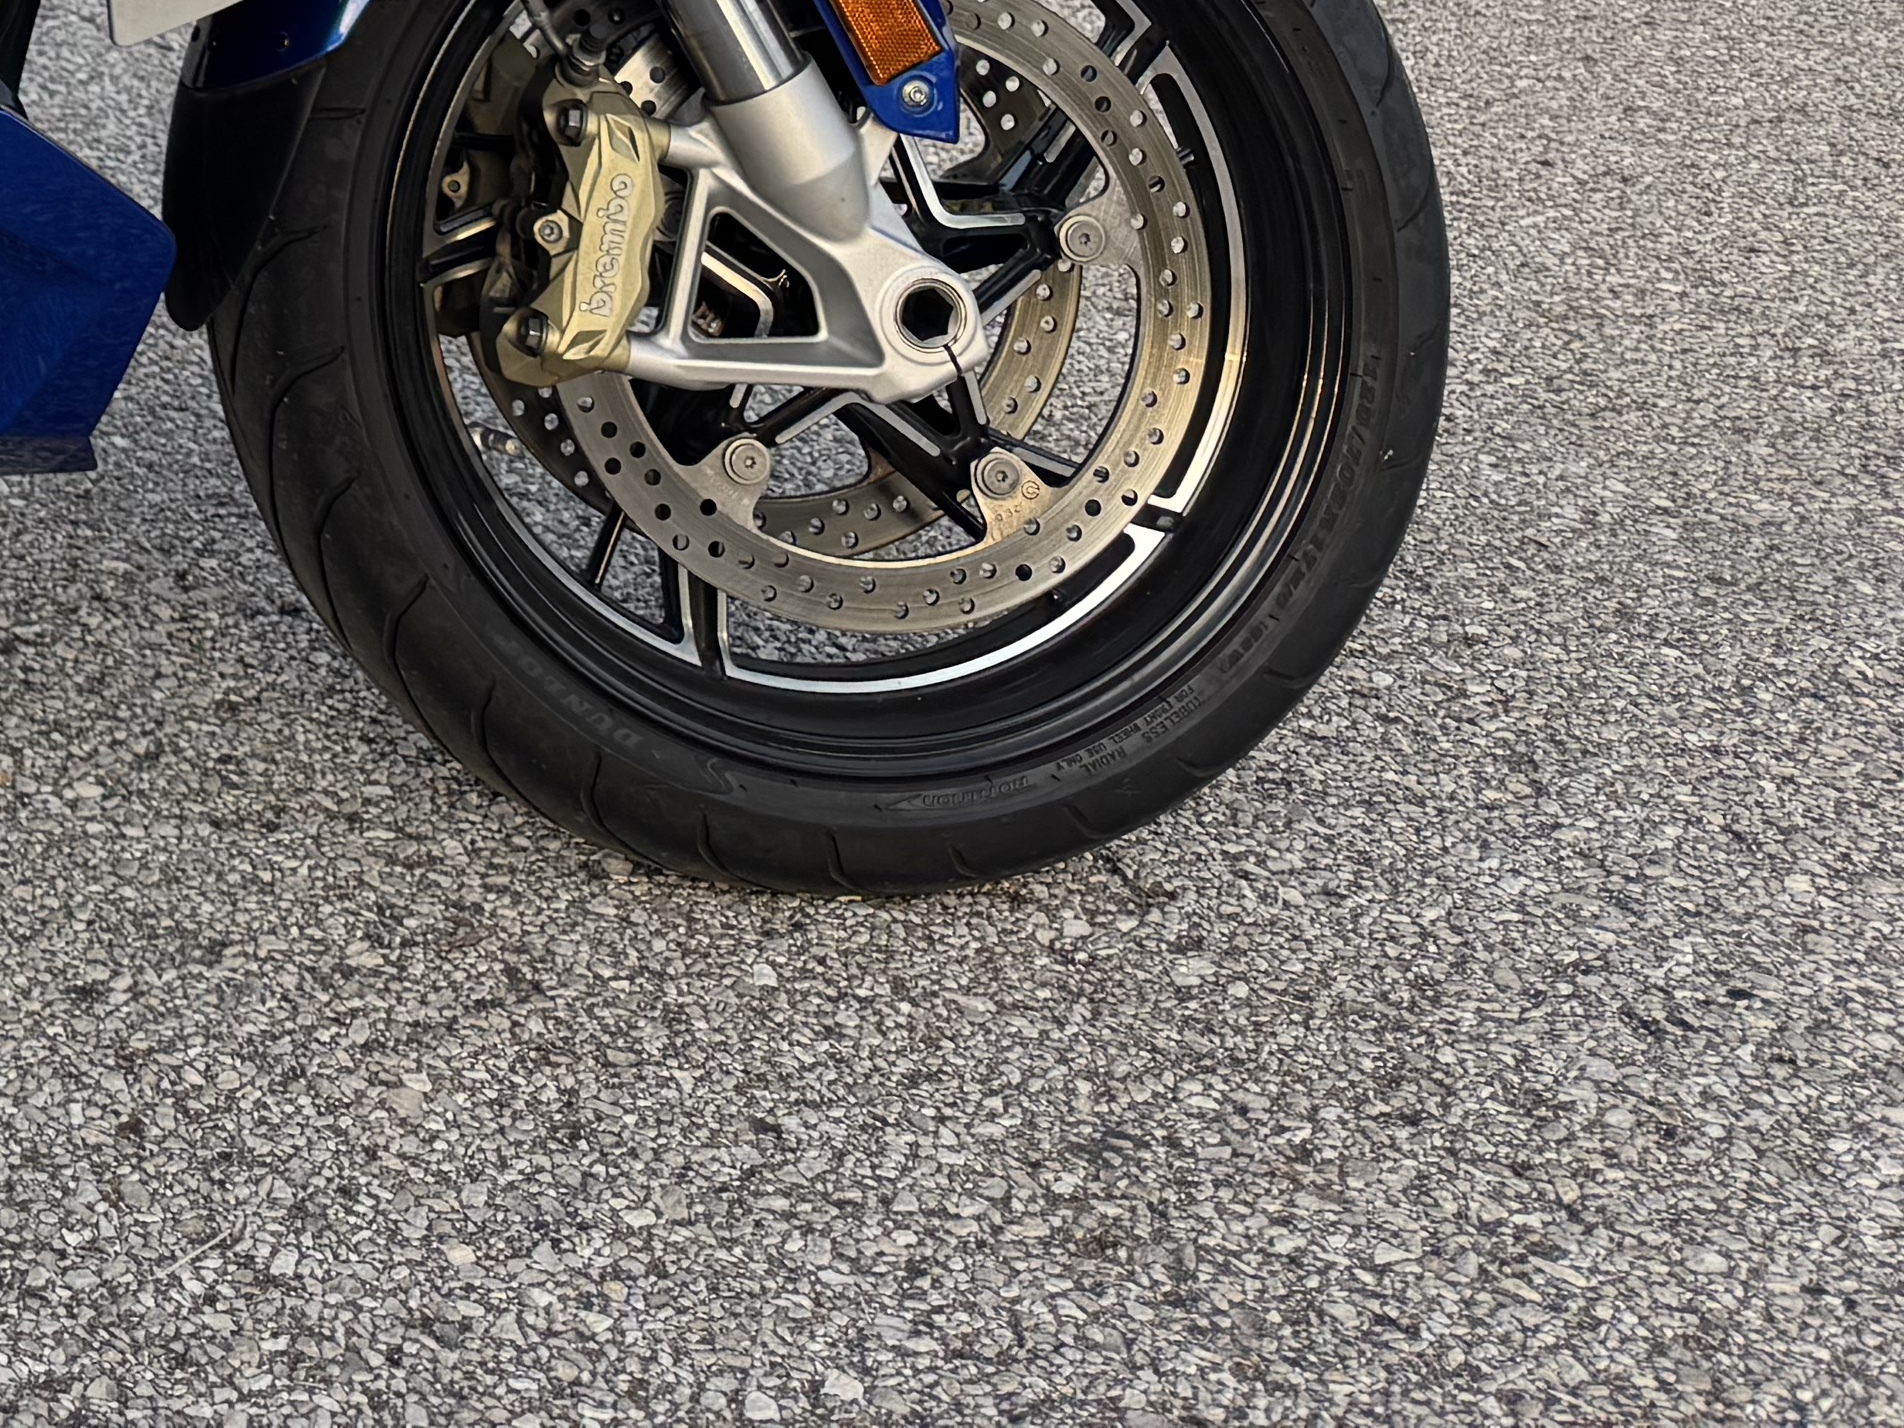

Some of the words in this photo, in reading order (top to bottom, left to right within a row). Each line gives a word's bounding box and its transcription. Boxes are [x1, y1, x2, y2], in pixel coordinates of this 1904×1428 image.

[579, 173, 635, 318] brembo
[1141, 696, 1203, 745] TUBELESS
[1082, 745, 1127, 777] RADIAL
